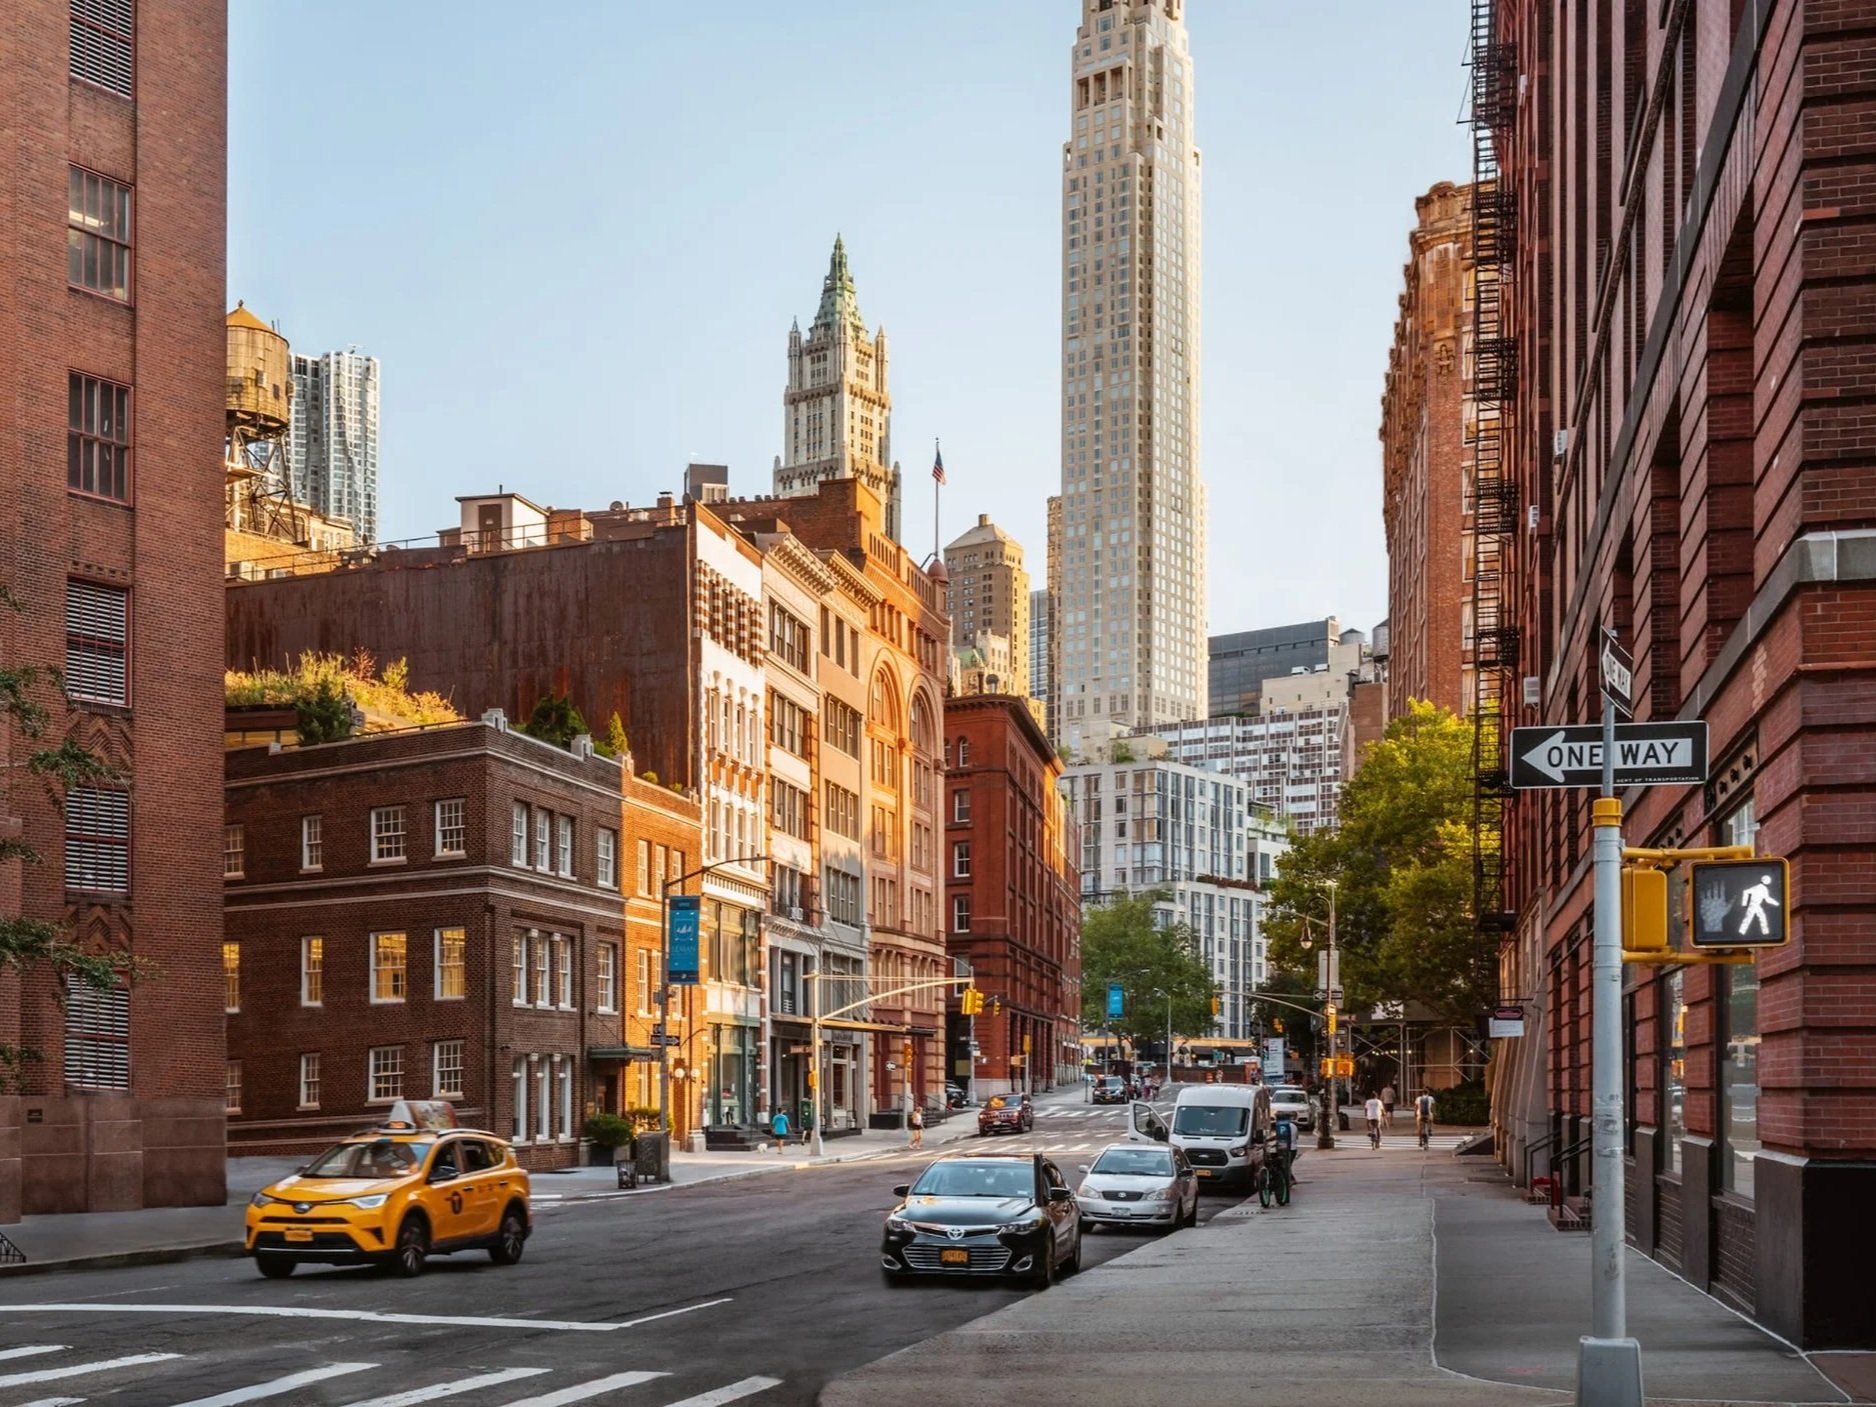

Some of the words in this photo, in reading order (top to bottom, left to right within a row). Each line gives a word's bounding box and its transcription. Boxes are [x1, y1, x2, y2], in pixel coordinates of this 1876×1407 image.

[1617, 663, 1629, 695] WAY
[1547, 744, 1603, 768] ONE
[1620, 741, 1679, 766] WAY
[1280, 1126, 1286, 1134] P
